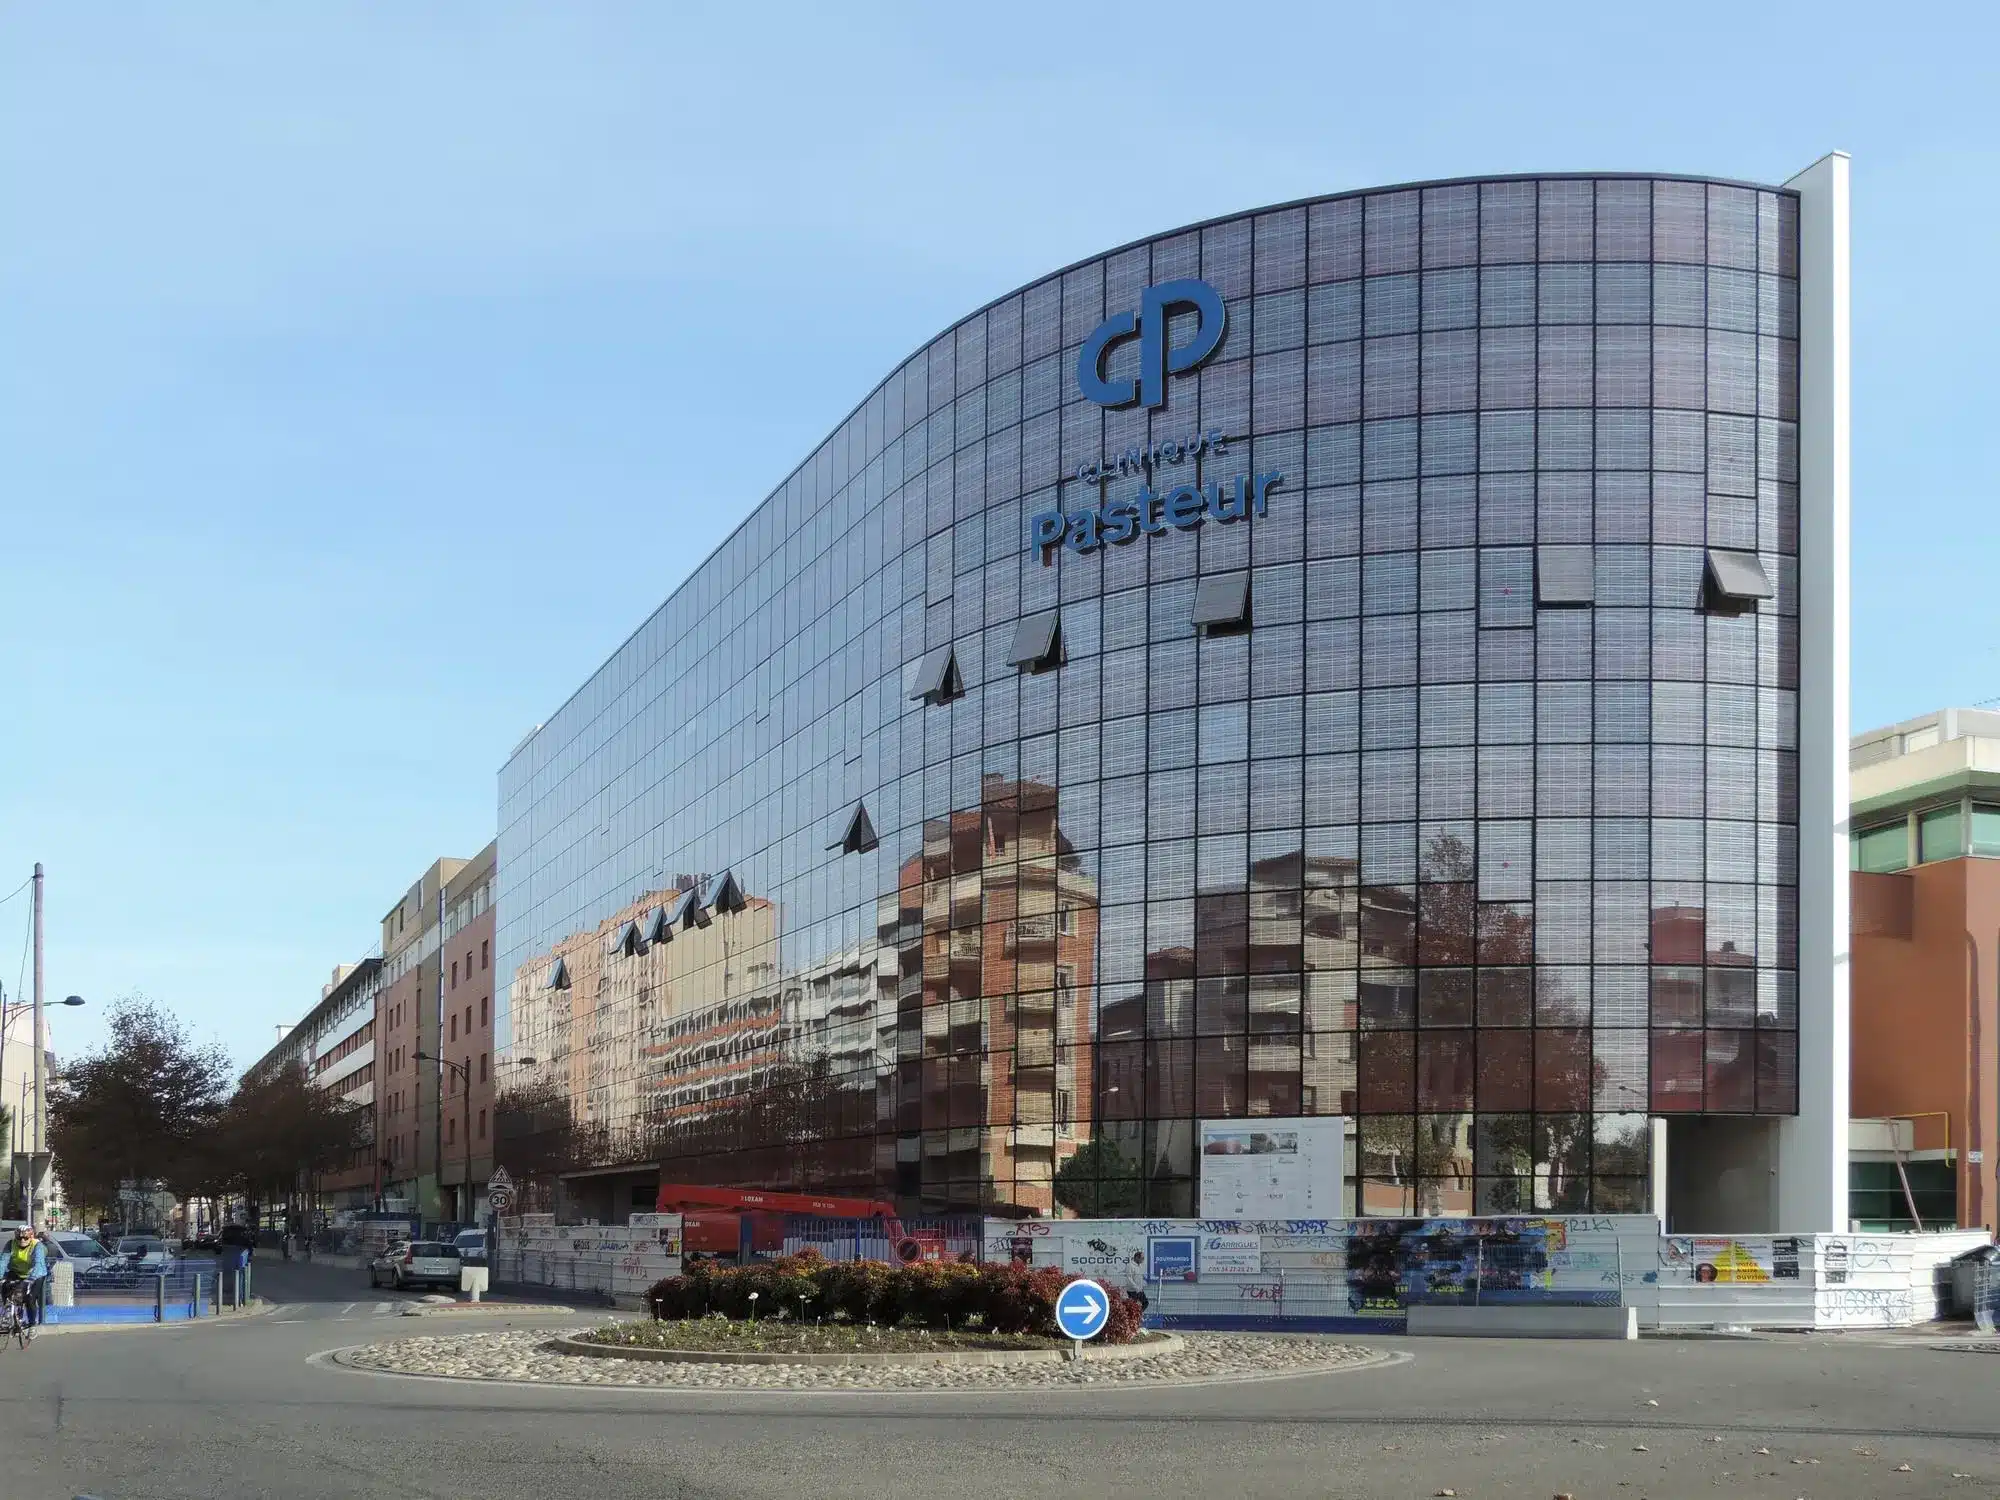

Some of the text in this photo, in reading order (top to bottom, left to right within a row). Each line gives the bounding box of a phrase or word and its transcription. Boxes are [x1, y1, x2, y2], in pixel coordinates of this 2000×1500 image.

[1077, 428, 1226, 481] CLINIQUE
[1031, 470, 1284, 563] Pasteur
[493, 1195, 508, 1206] 30
[1209, 1237, 1259, 1251] GARRIGUES
[1071, 1254, 1134, 1266] socotra
